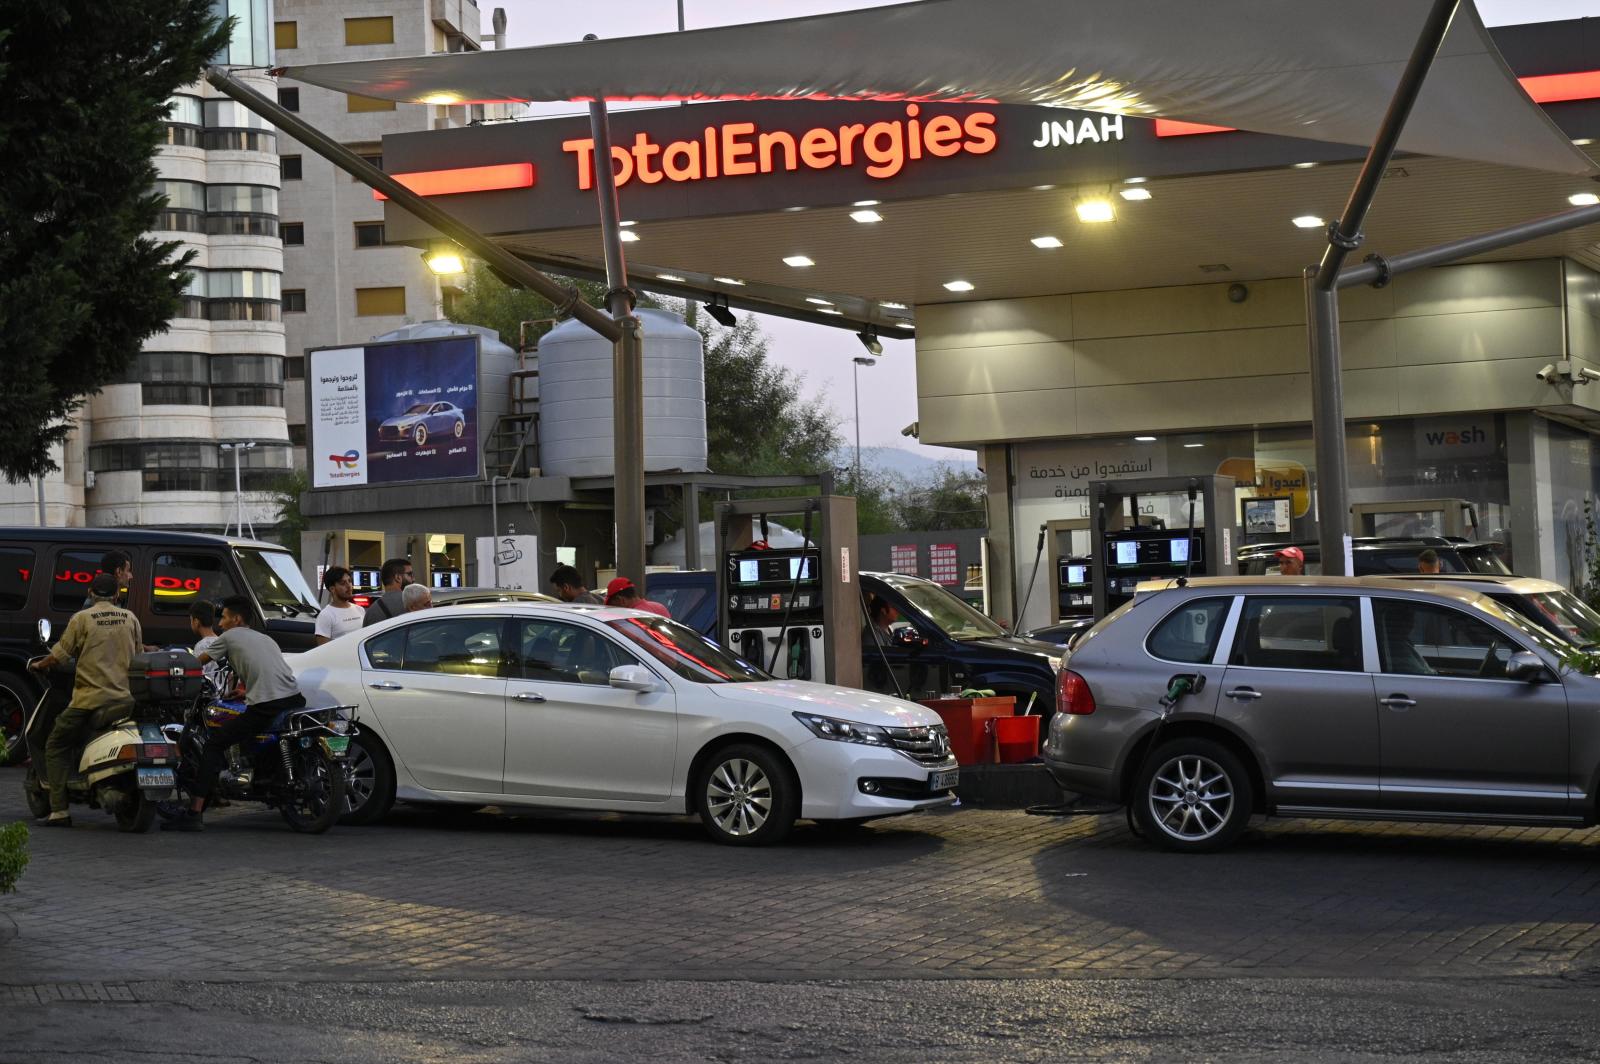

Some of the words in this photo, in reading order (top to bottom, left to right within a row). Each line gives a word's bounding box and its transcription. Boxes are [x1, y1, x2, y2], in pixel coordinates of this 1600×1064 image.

[1033, 115, 1124, 148] JNAH
[562, 103, 996, 190] TotalEnergies
[1425, 425, 1485, 445] wash
[1030, 464, 1066, 479] خدمة
[1070, 465, 1090, 479] من
[1095, 458, 1152, 479] استفيدوا
